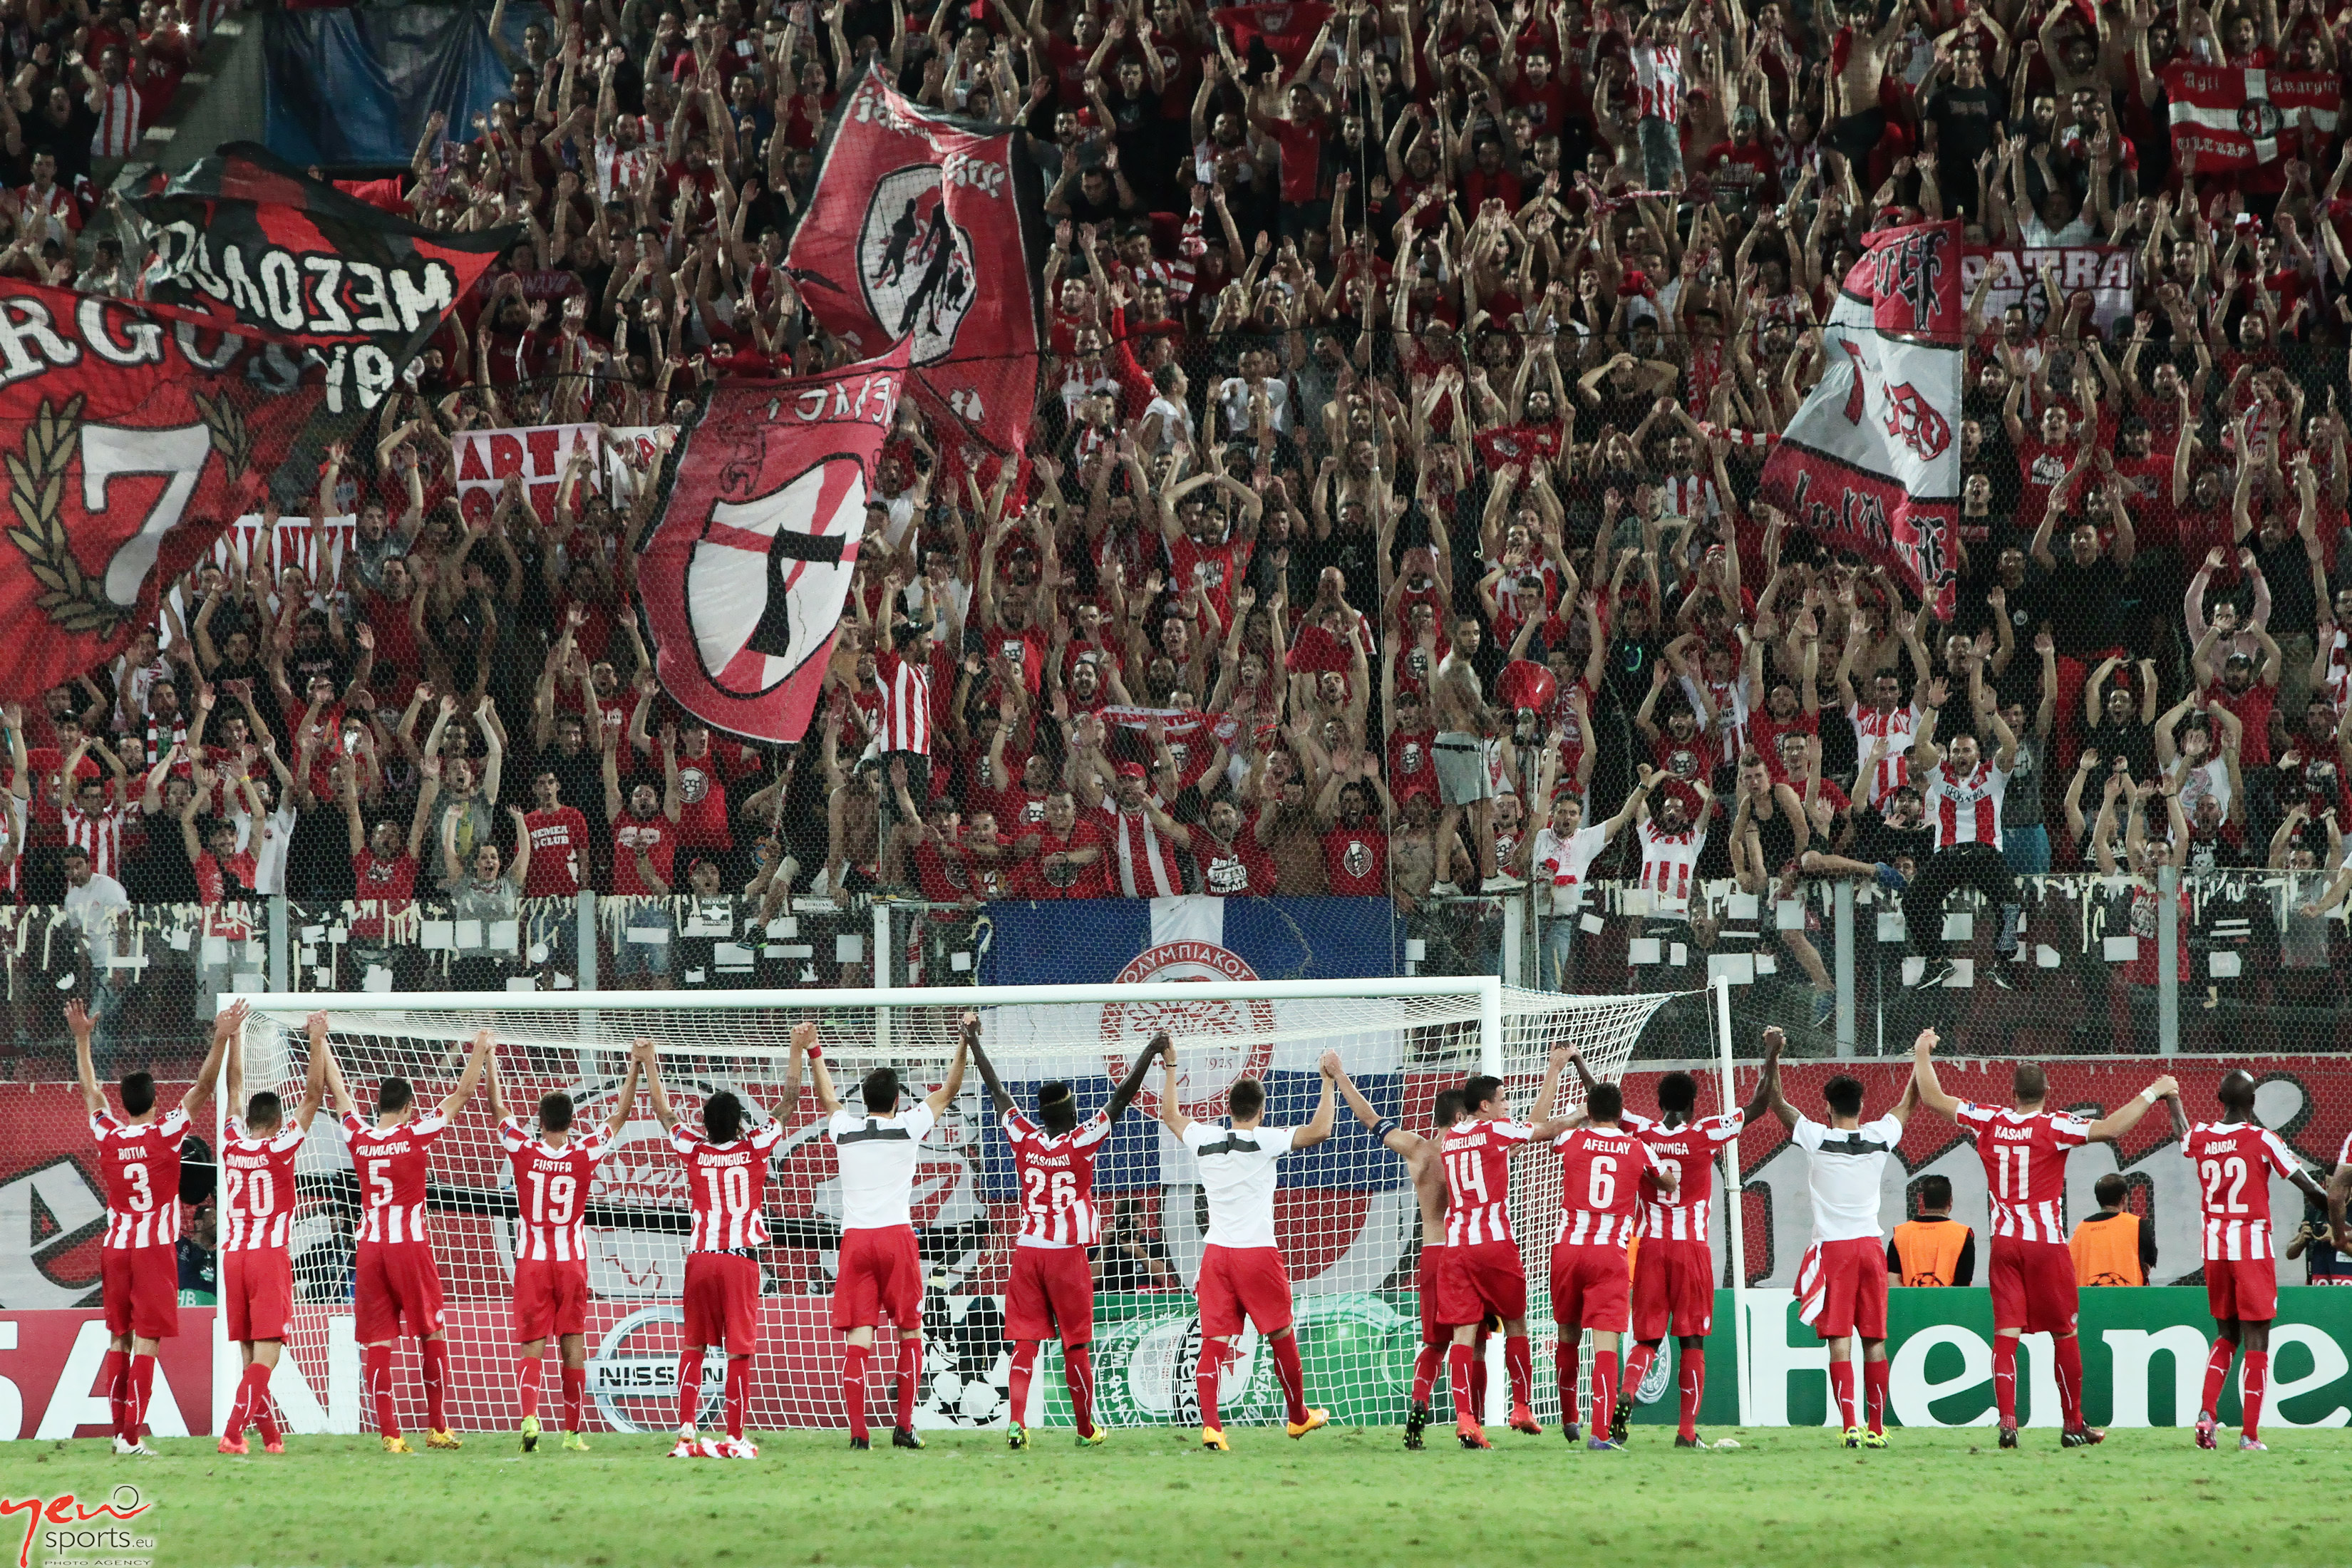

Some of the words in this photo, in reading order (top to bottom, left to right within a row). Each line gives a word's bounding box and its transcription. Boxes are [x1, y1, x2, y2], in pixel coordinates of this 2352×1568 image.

[82, 423, 210, 606] 7
[530, 825, 569, 839] NEMEA
[540, 835, 569, 846] CLUB
[1124, 944, 1250, 983] ΟΛΥΜΠΙΑΚΟΣ
[1205, 1057, 1233, 1071] 1925
[118, 1145, 148, 1161] BOTIA
[1582, 1137, 1631, 1155] AFELLAY
[1650, 1141, 1690, 1157] NDINGA
[1993, 1124, 2033, 1141] KASAMI
[532, 1157, 573, 1173] FUSTER
[697, 1150, 753, 1167] DOMINGUEZ
[1444, 1149, 1490, 1209] 14
[1993, 1145, 2031, 1201] 11
[123, 1162, 153, 1212] 3
[226, 1168, 275, 1219] 20
[367, 1159, 394, 1207] 5
[527, 1170, 577, 1225] 19
[700, 1165, 751, 1215] 10
[1023, 1167, 1077, 1214] 26
[1588, 1155, 1617, 1209] 6
[2201, 1155, 2249, 1214] 22
[598, 1365, 725, 1387] NISSN
